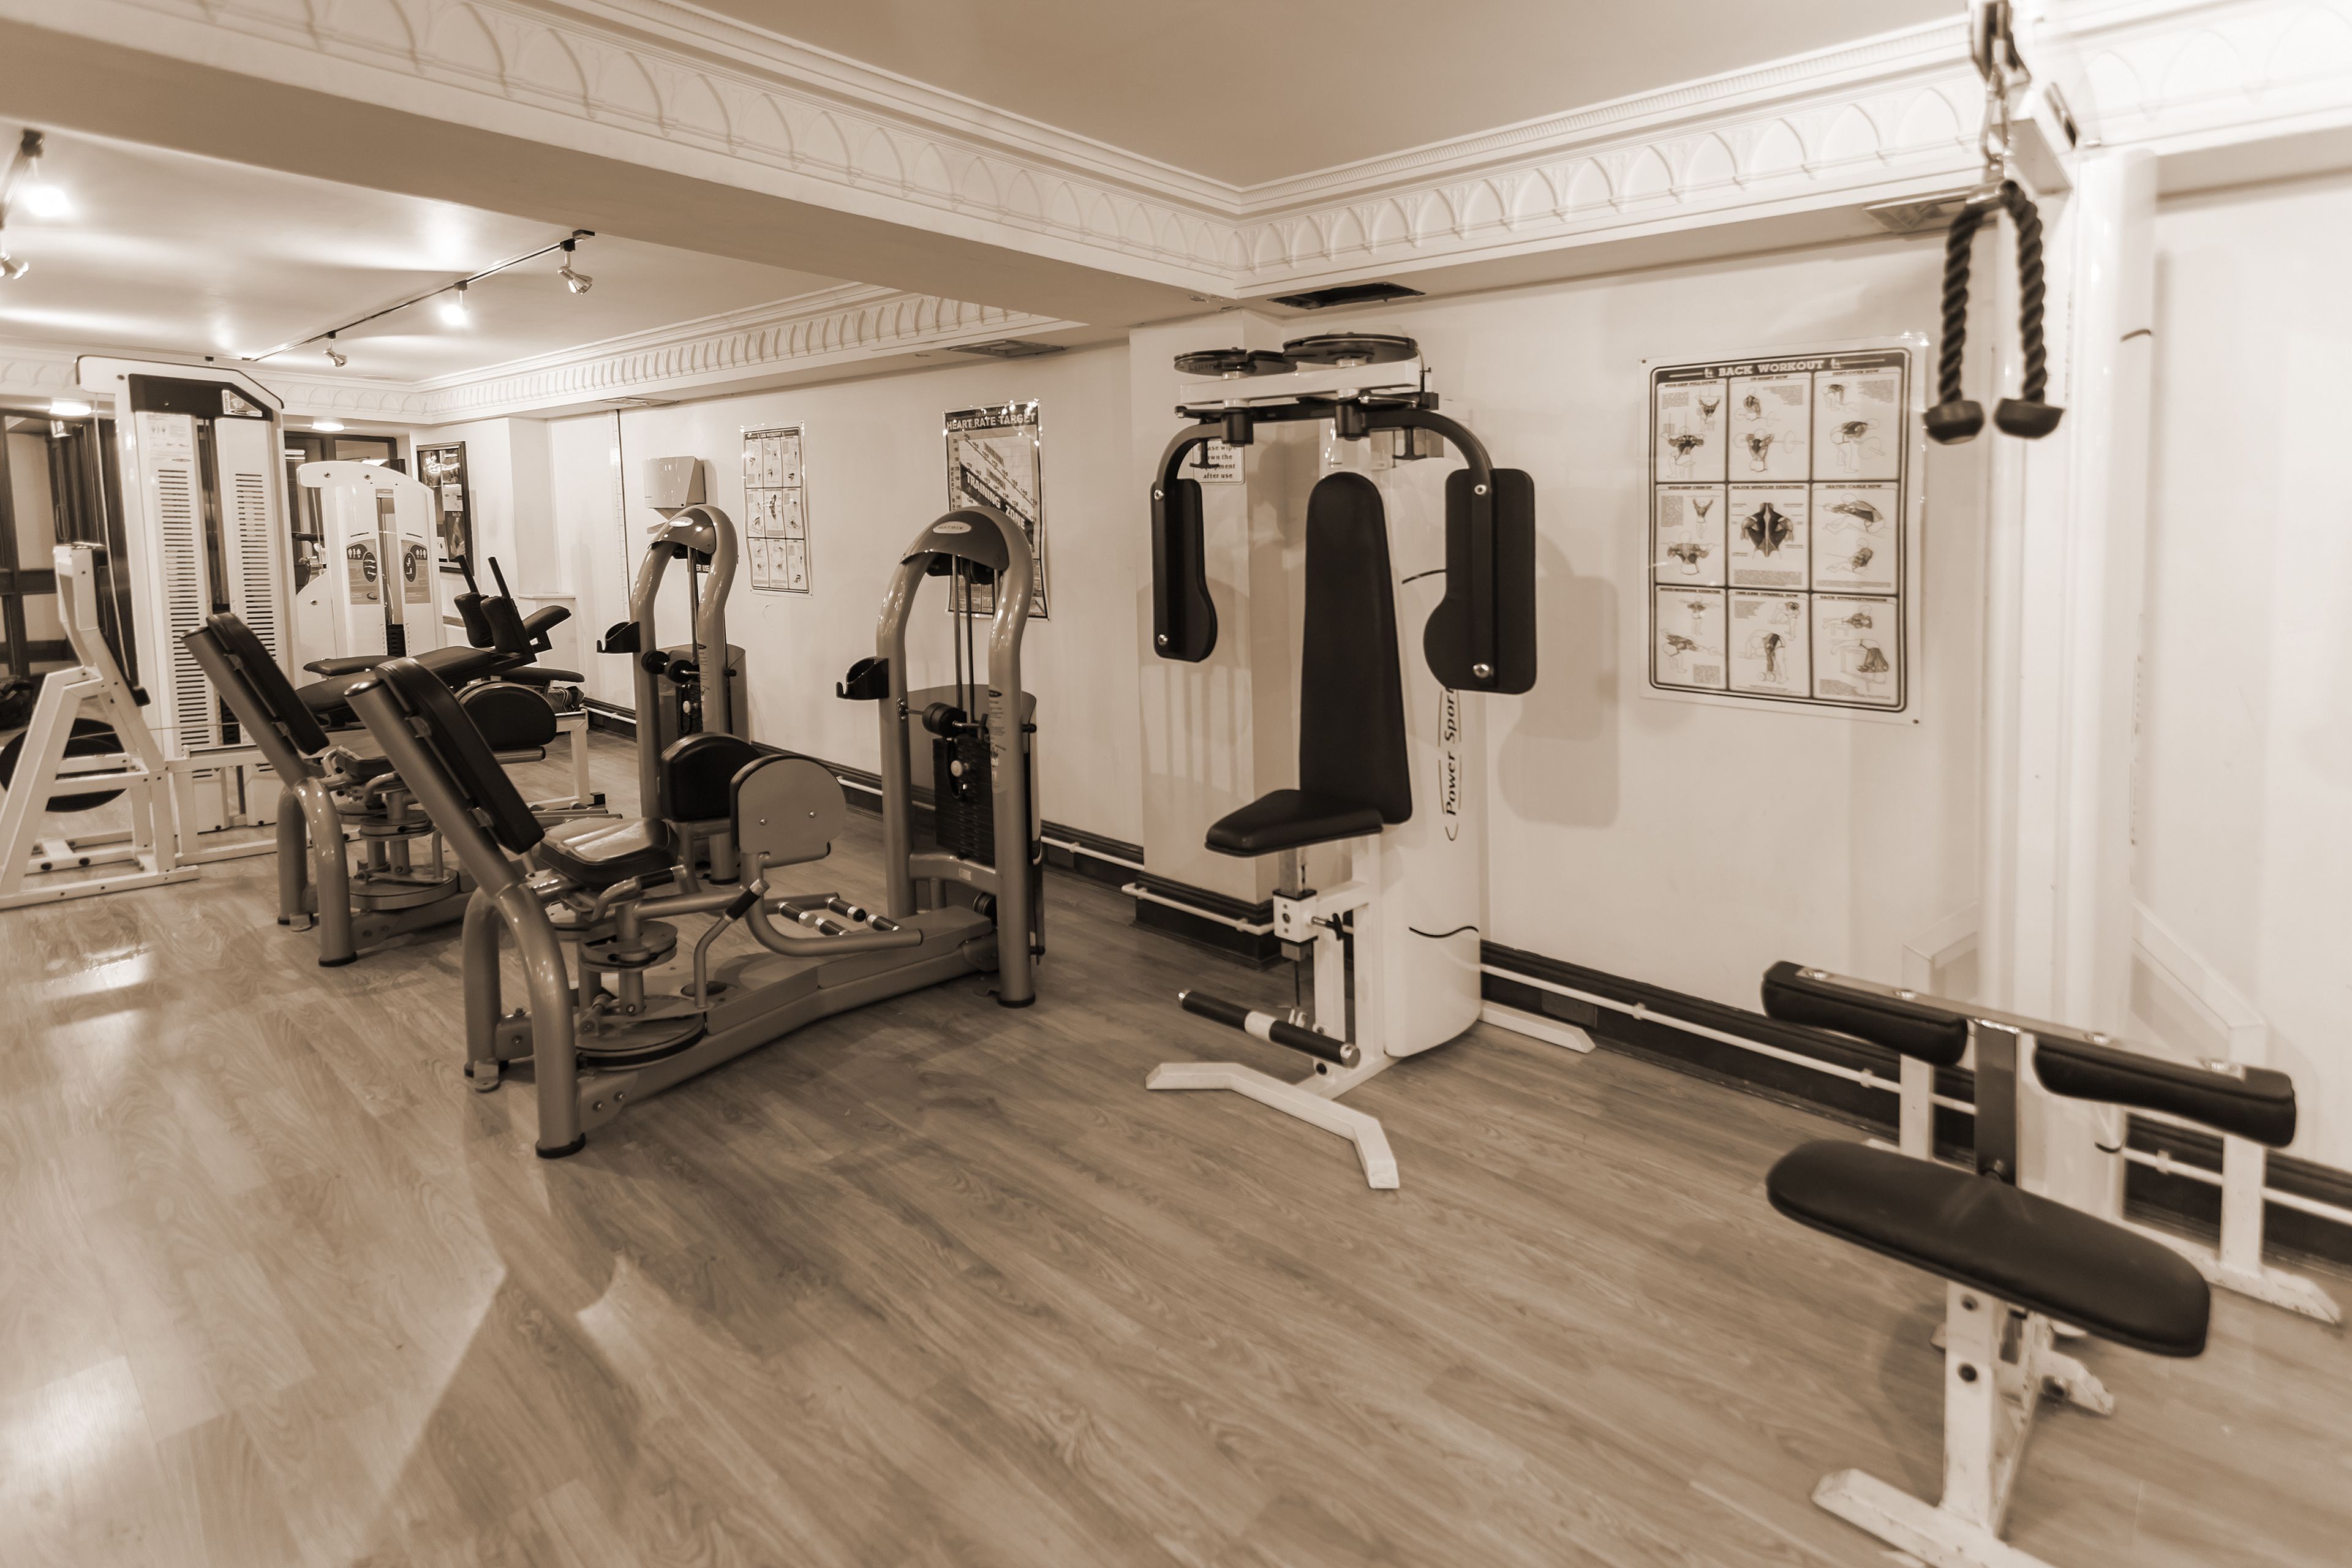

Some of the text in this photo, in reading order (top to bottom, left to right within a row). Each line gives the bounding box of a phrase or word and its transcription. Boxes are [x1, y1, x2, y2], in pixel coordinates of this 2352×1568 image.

[1718, 360, 1825, 377] BACK WORKOUT
[946, 419, 973, 430] HEART
[974, 417, 997, 427] RATE
[998, 412, 1036, 425] TARGET
[965, 471, 1000, 509] TRAINING
[1005, 504, 1025, 530] ZONE
[1446, 751, 1456, 816] Power
